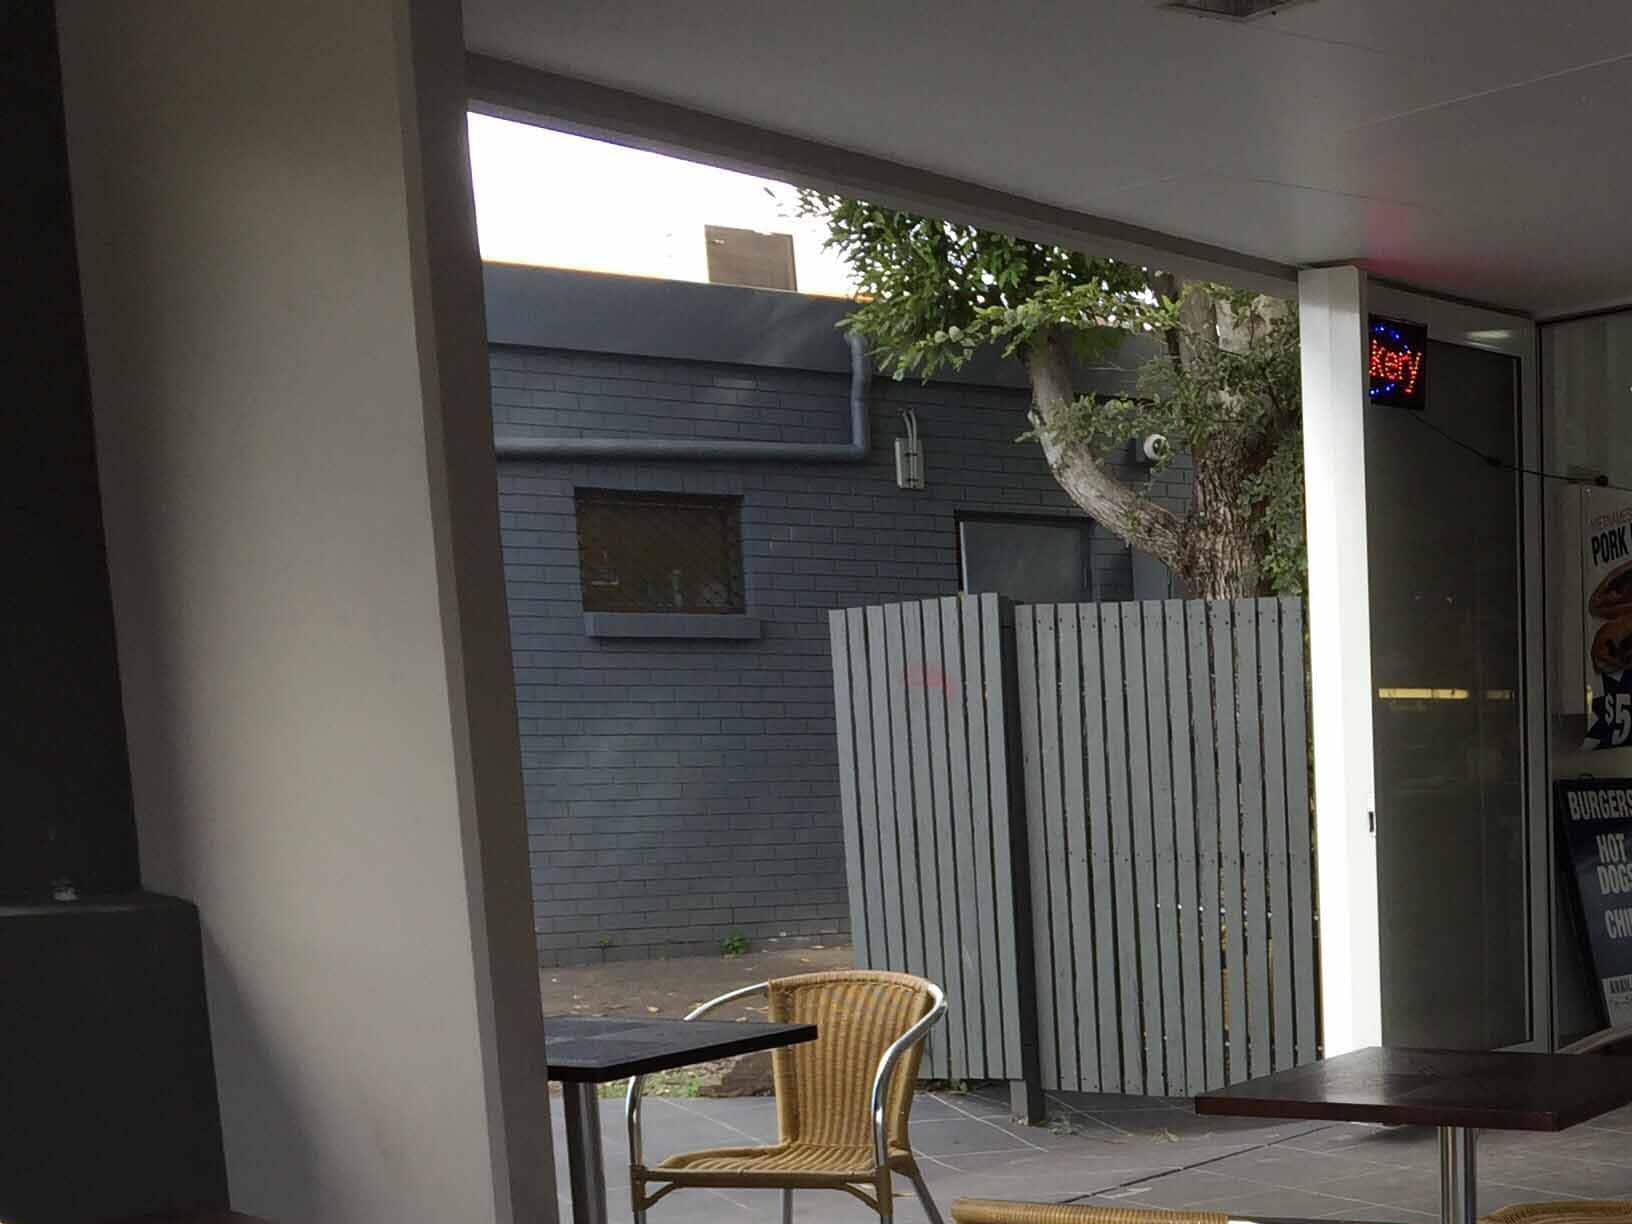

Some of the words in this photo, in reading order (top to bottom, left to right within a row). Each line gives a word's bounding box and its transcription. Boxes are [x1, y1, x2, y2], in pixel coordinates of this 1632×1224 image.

[1368, 337, 1424, 395] kery
[1591, 525, 1629, 567] PORK
[1598, 834, 1626, 864] HOT
